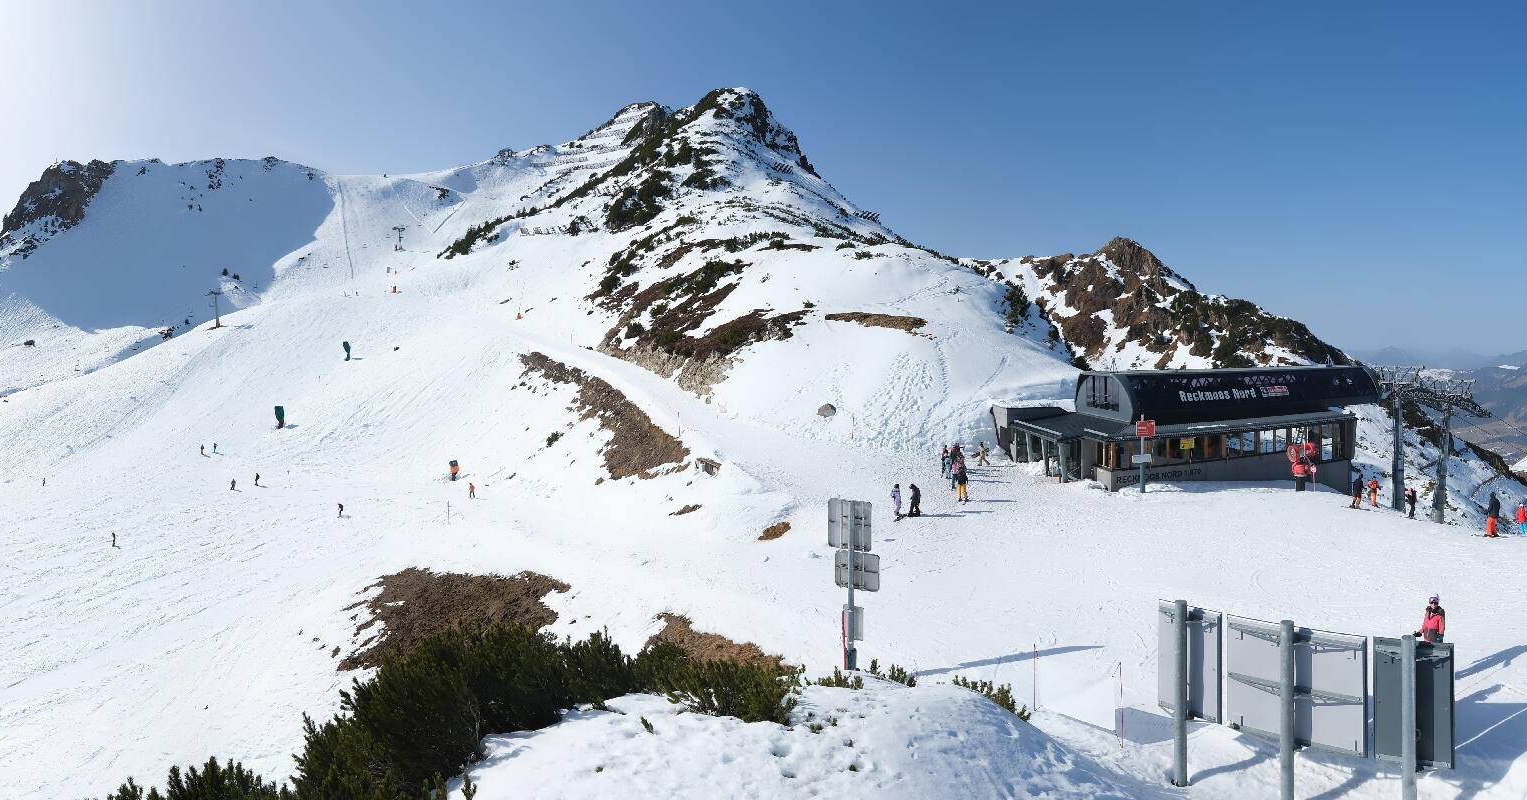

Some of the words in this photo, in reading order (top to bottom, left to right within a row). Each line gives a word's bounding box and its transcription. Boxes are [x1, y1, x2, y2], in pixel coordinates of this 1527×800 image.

[1179, 390, 1230, 402] Reckmoos
[1232, 387, 1256, 399] Nord
[1116, 472, 1160, 484] RECKOOS
[1162, 470, 1183, 480] NORD
